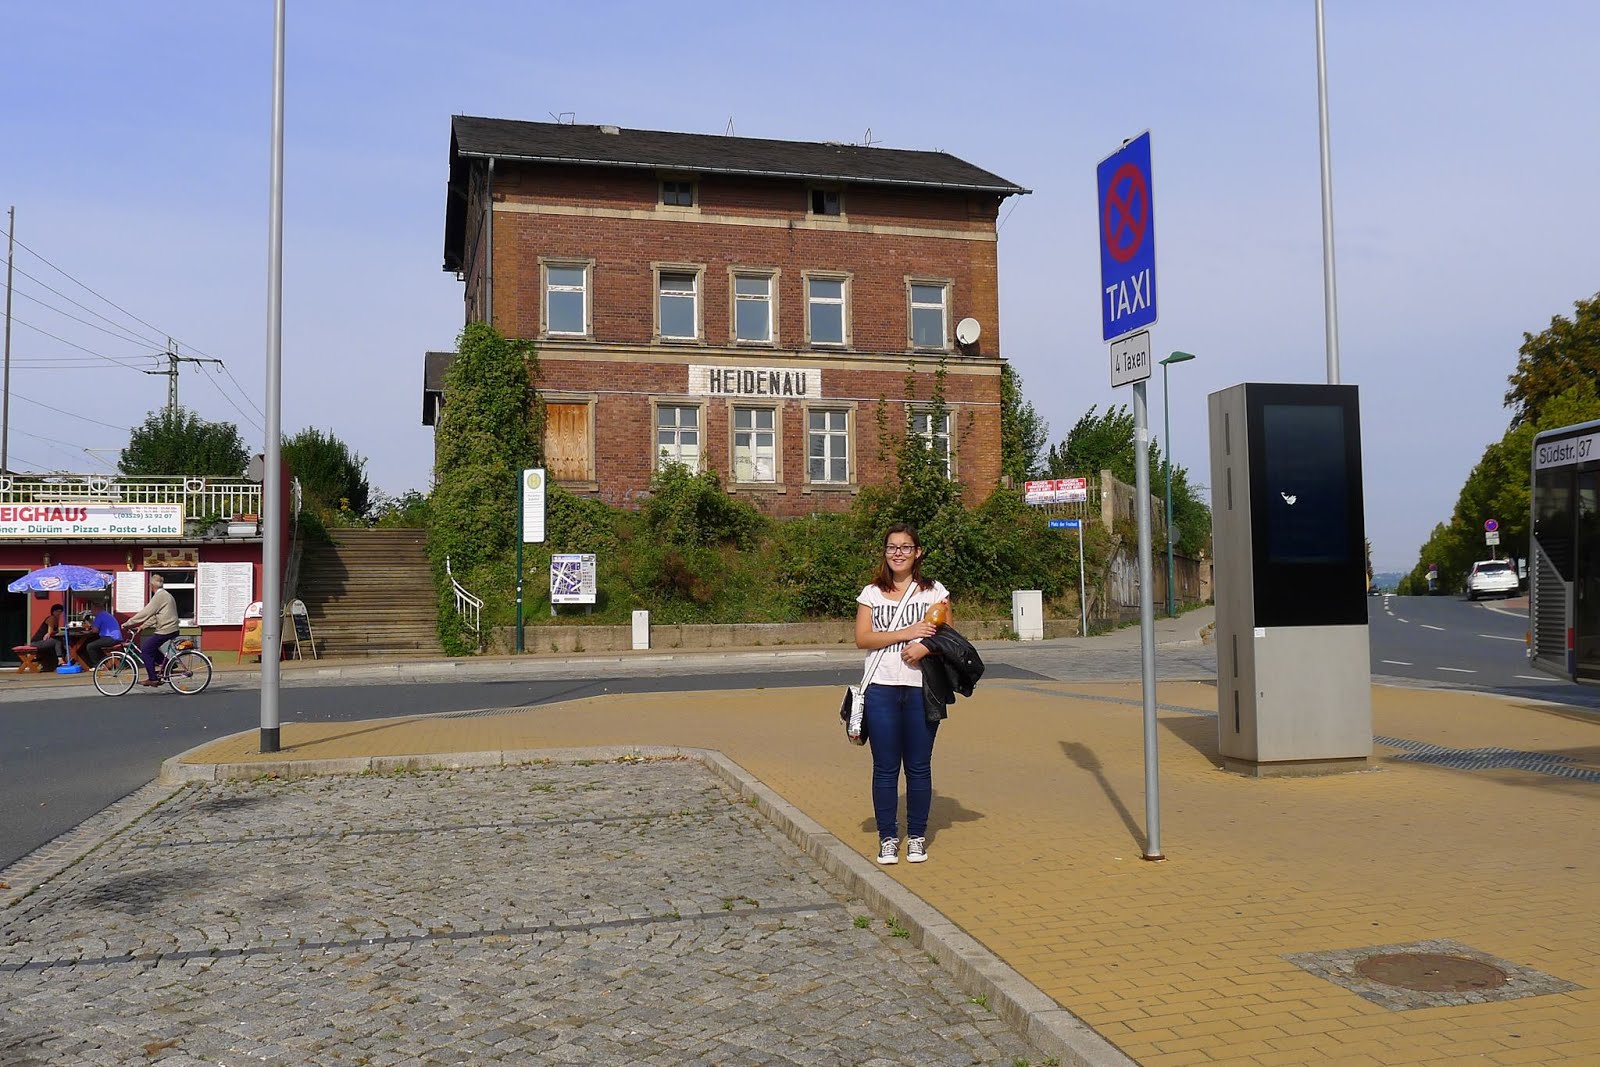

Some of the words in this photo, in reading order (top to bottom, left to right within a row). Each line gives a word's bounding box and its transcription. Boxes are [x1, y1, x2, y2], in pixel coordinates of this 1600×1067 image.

[1106, 268, 1151, 322] TAXI
[1115, 354, 1121, 373] 4
[1123, 351, 1146, 372] Taxen
[710, 368, 807, 396] HEIDENAU
[1539, 443, 1575, 464] Südstr.
[1578, 438, 1592, 458] 37
[28, 524, 63, 533] Dürüm
[72, 524, 99, 533] Pizza
[109, 524, 137, 533] Pasta
[147, 524, 178, 533] Salate
